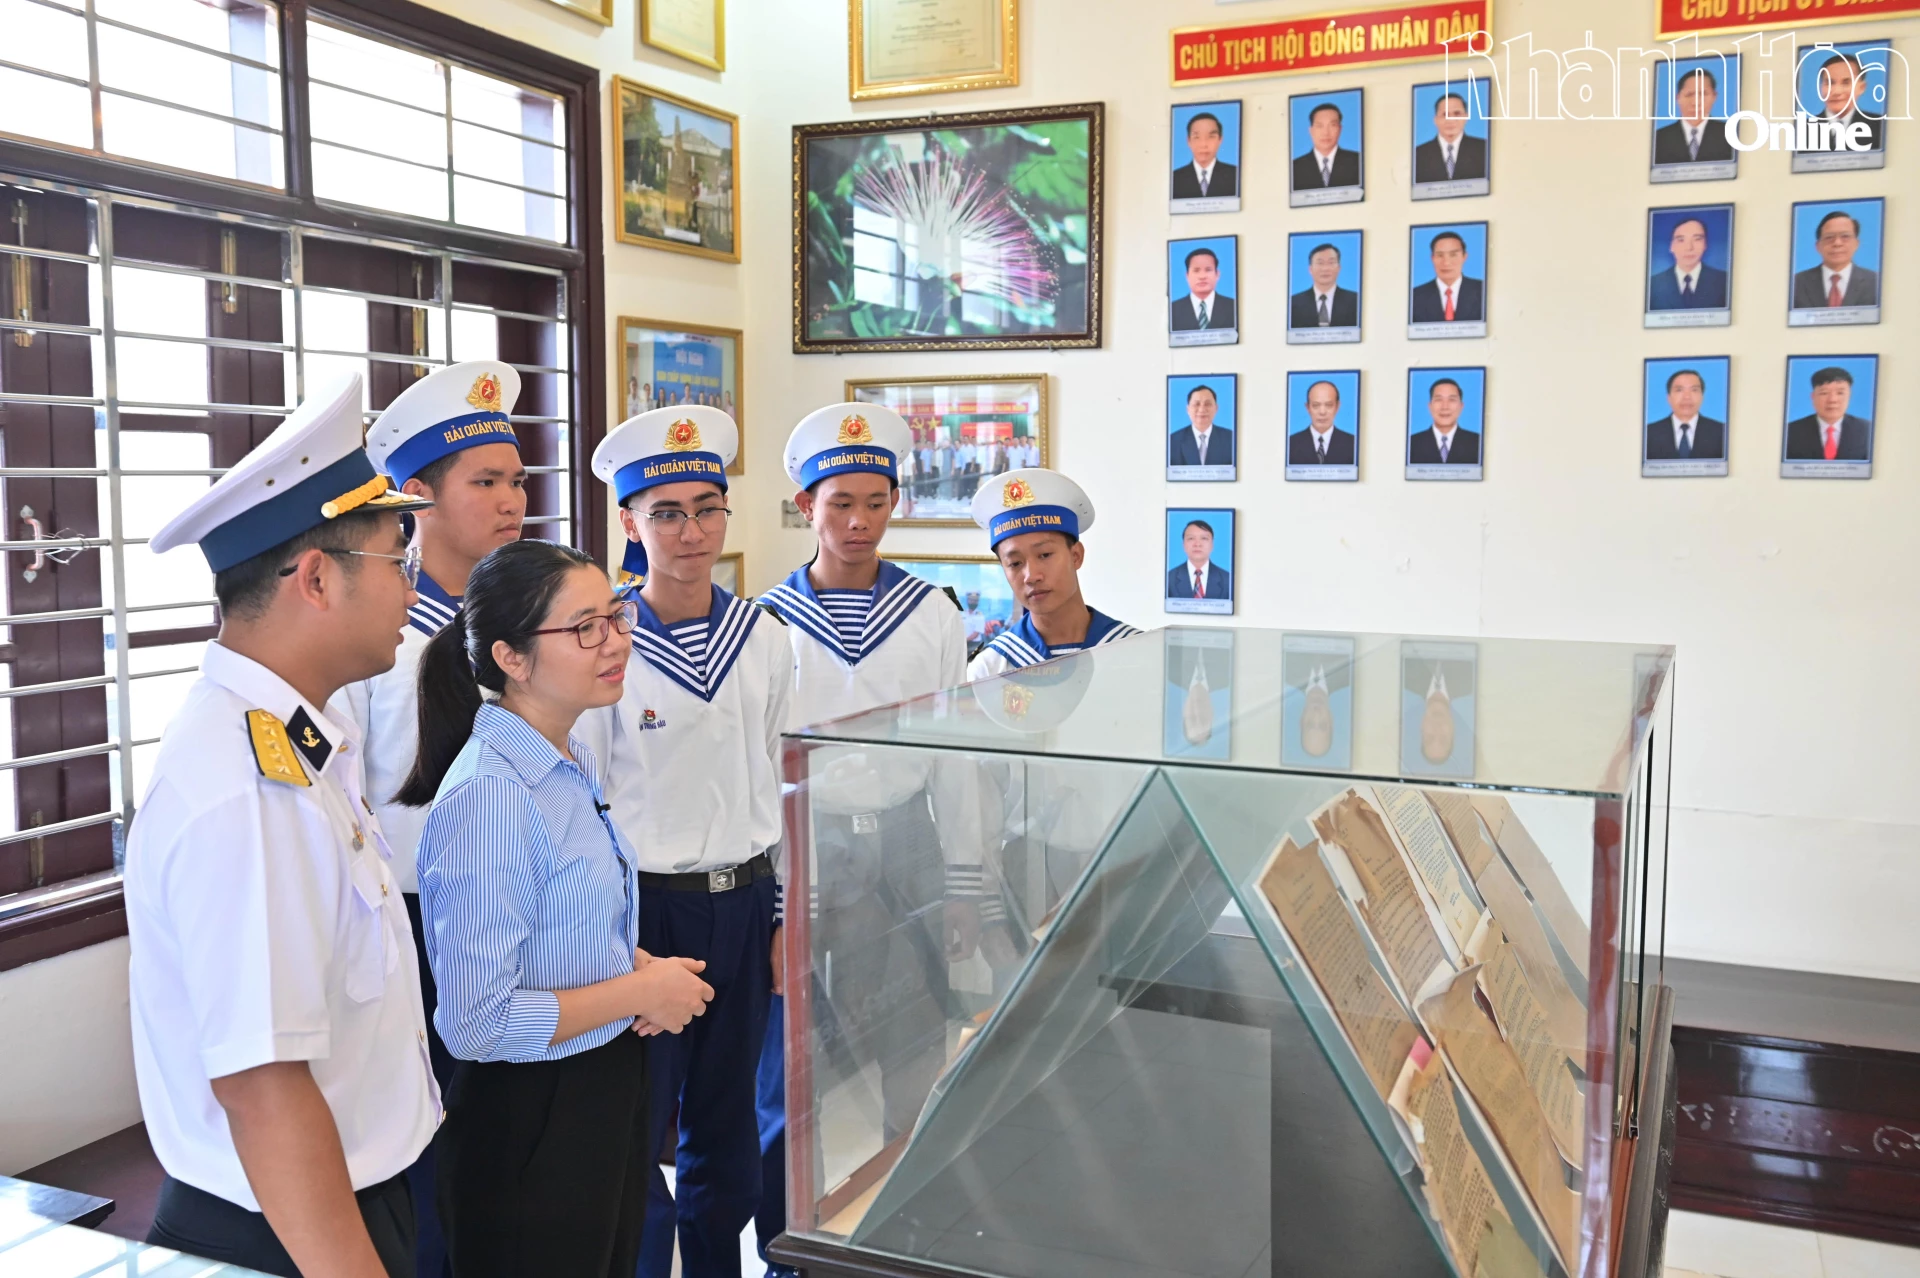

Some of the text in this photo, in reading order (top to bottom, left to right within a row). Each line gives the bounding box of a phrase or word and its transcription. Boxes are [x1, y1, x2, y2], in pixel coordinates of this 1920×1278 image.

[1179, 33, 1218, 71] CHỦ
[1223, 37, 1266, 70] TỊCH
[1271, 28, 1305, 66] HỘI
[1371, 15, 1429, 51] NHÂN
[1434, 10, 1480, 43] DÂN
[443, 425, 465, 444] HẢI
[464, 420, 494, 437] QUÂN
[644, 457, 722, 478] HẢI QUÂN VIỆT NAM
[817, 451, 890, 471] HẢI QUÂN VIỆT NAM
[1002, 517, 1022, 532] QUÂN
[1022, 513, 1042, 528] VIỆT
[1043, 515, 1062, 525] NAM
